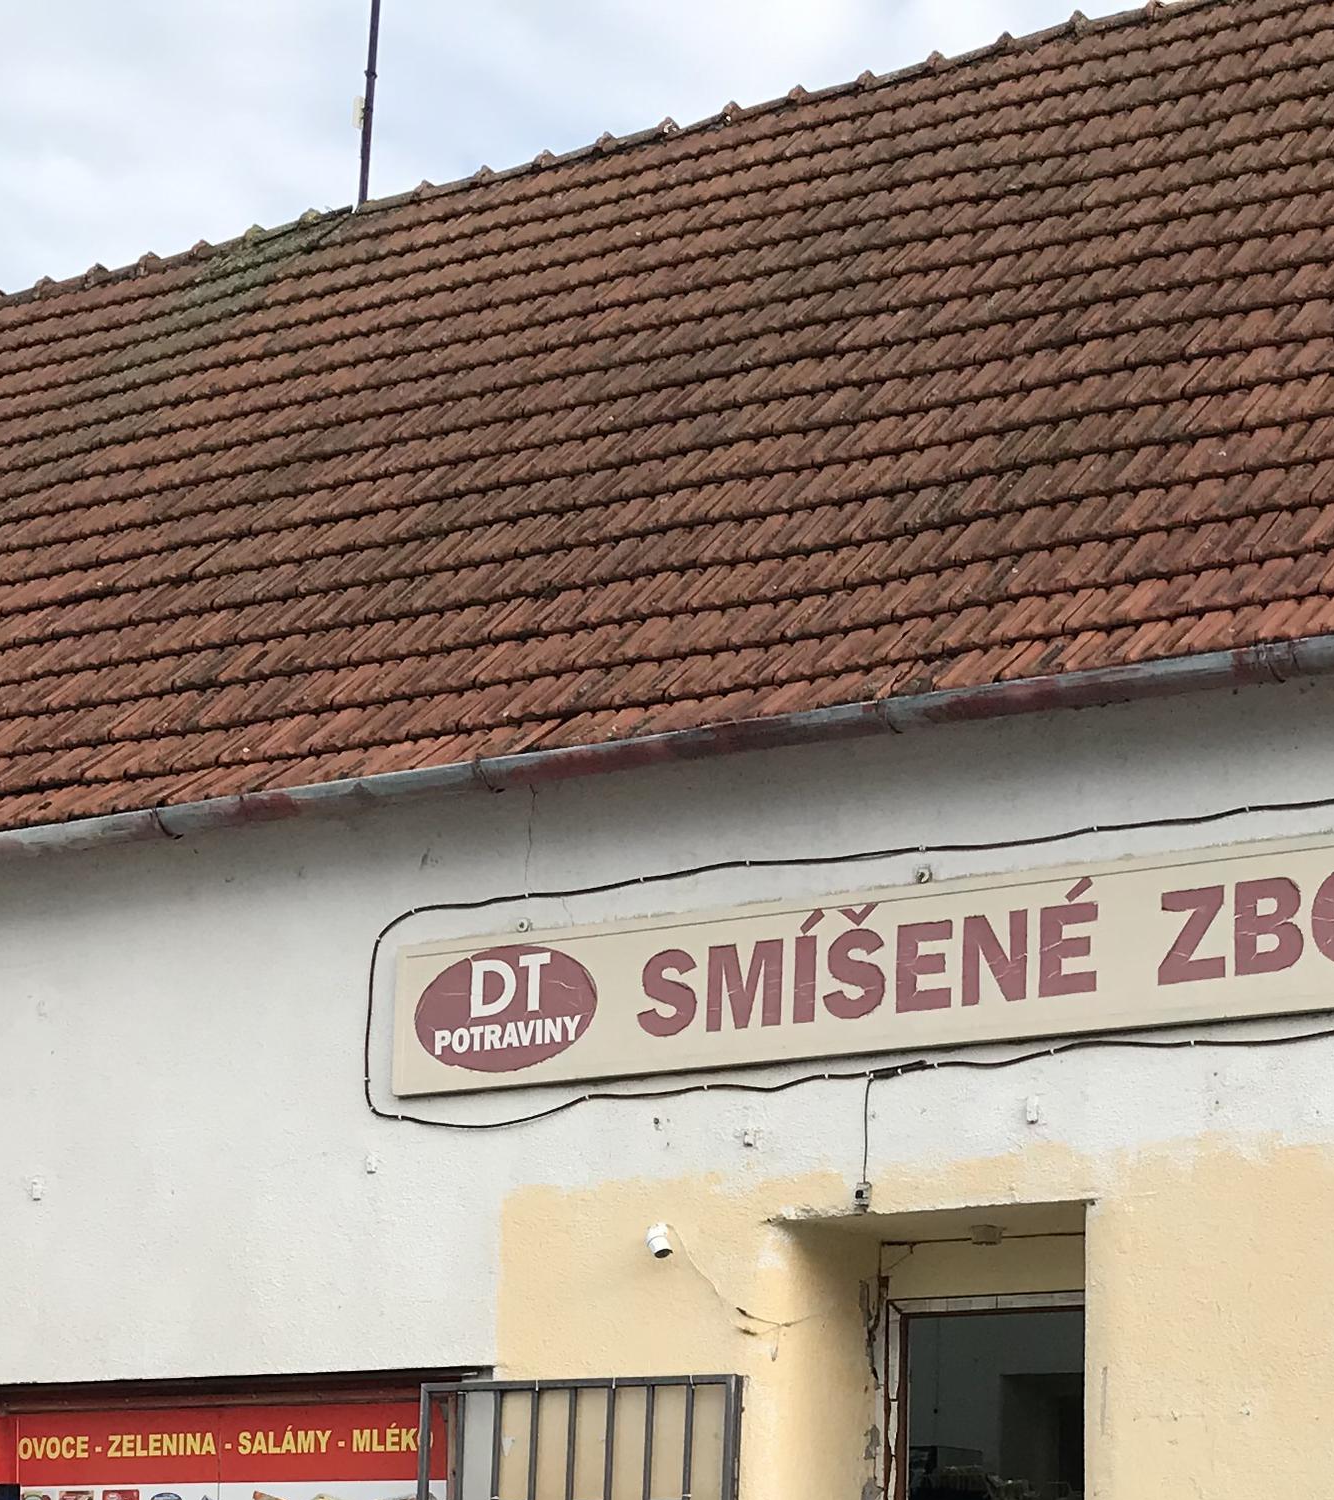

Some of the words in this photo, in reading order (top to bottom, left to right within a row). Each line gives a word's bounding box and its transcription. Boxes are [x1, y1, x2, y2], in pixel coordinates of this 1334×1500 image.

[636, 876, 1099, 1038] SMÍŠENÉ
[470, 951, 552, 1018] DT
[434, 1014, 583, 1056] POTRAVINY
[18, 1436, 89, 1460] OVOCE
[107, 1432, 217, 1458] ZELENINA
[238, 1425, 332, 1455] SALÁMY
